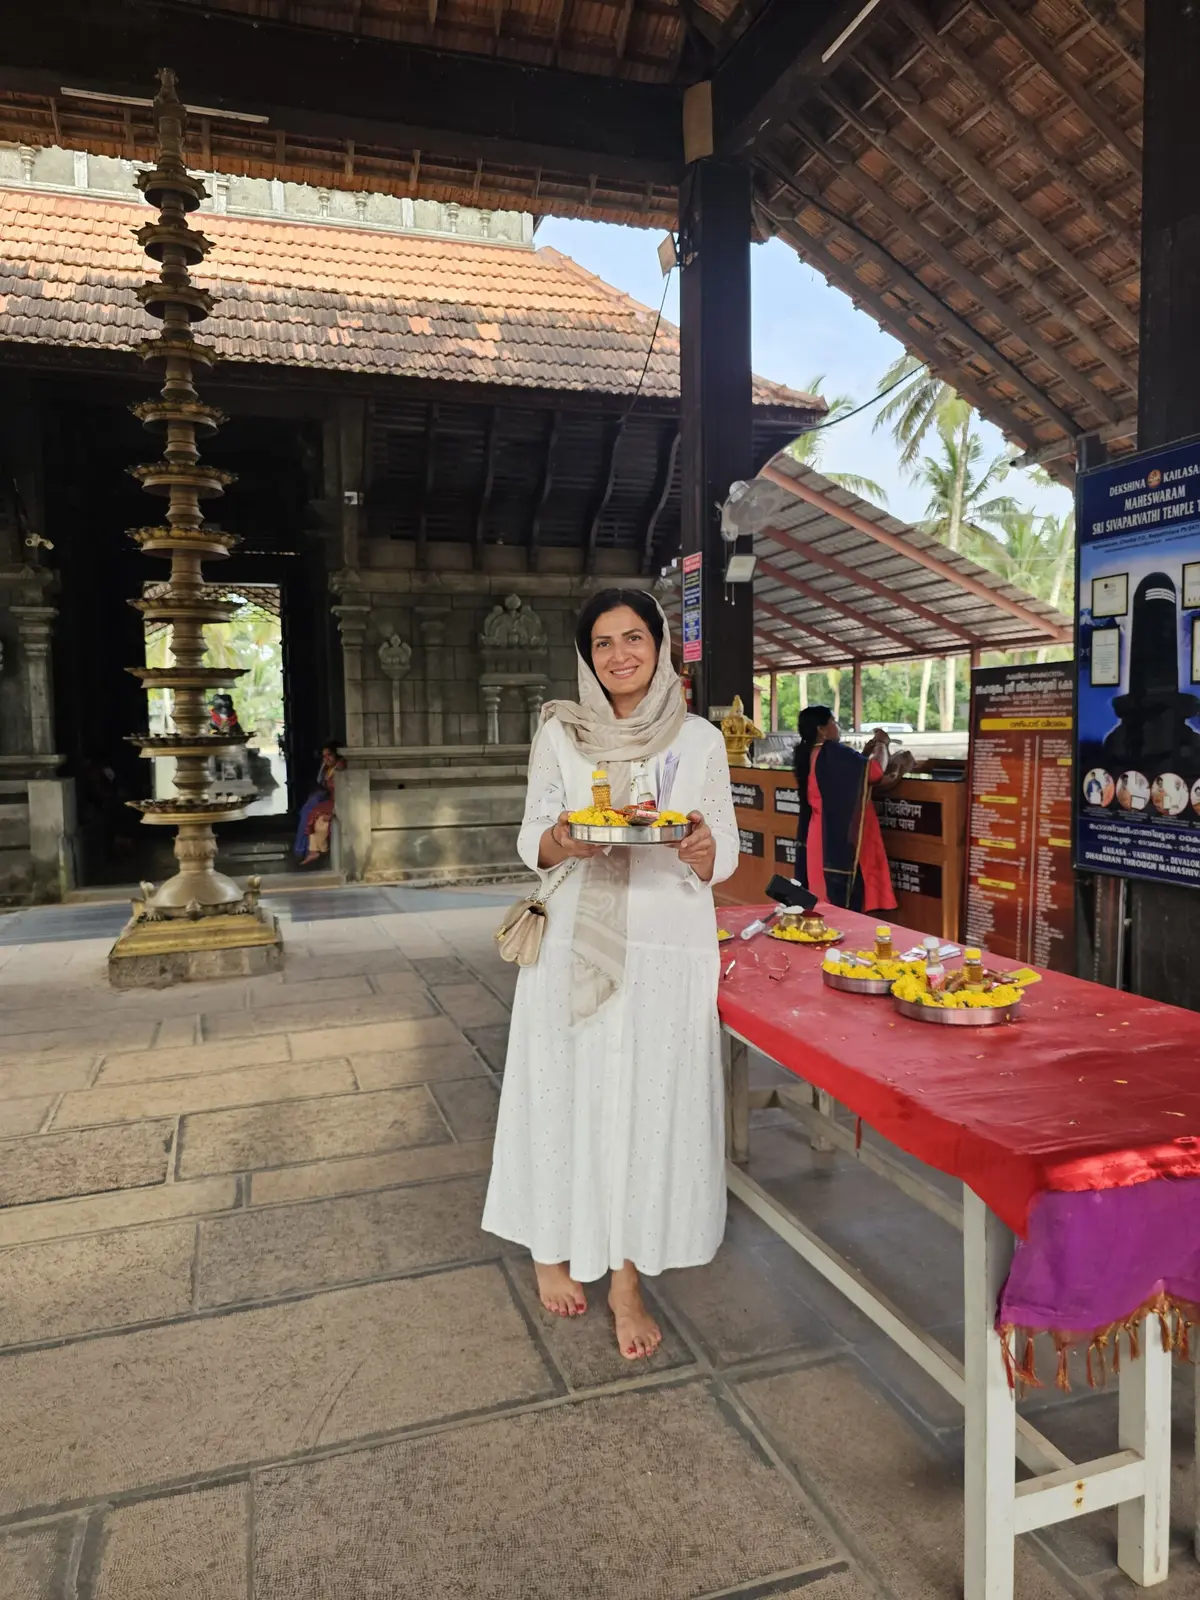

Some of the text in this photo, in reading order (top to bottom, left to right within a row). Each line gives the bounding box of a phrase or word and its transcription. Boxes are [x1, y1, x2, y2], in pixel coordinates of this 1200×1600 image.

[1109, 464, 1200, 497] DEKSHINA KAILASA
[1124, 485, 1186, 511] MAHESWARAM
[1092, 521, 1104, 535] SRI
[1105, 509, 1161, 532] SIVAPARVATHI
[1162, 502, 1195, 520] TEMPLE
[898, 818, 916, 831] पास
[1085, 851, 1200, 878] DHARSHAN THROUGH MAHASHIV
[1102, 846, 1127, 857] KAILASA
[1132, 851, 1164, 862] VAIKUNDA
